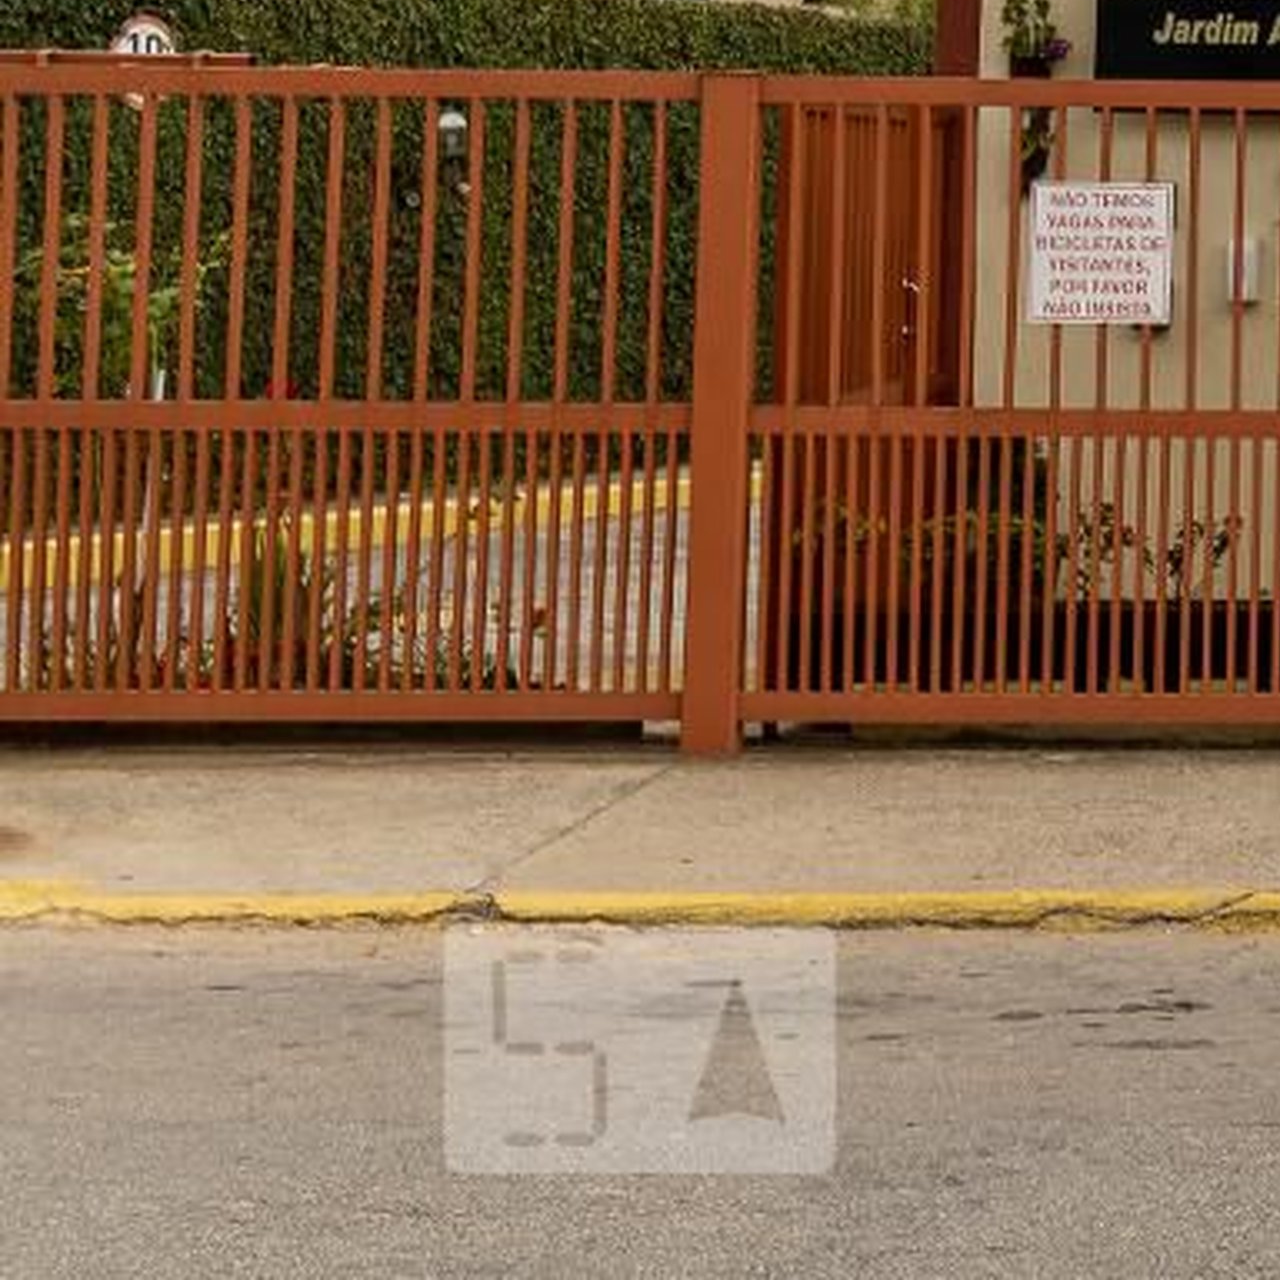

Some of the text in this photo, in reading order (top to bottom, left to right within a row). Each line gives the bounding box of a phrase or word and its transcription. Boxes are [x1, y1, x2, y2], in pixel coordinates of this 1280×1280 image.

[1153, 11, 1260, 45] Jardim
[1047, 214, 1104, 229] VAGAS
[1050, 279, 1148, 295] POR FAVOR
